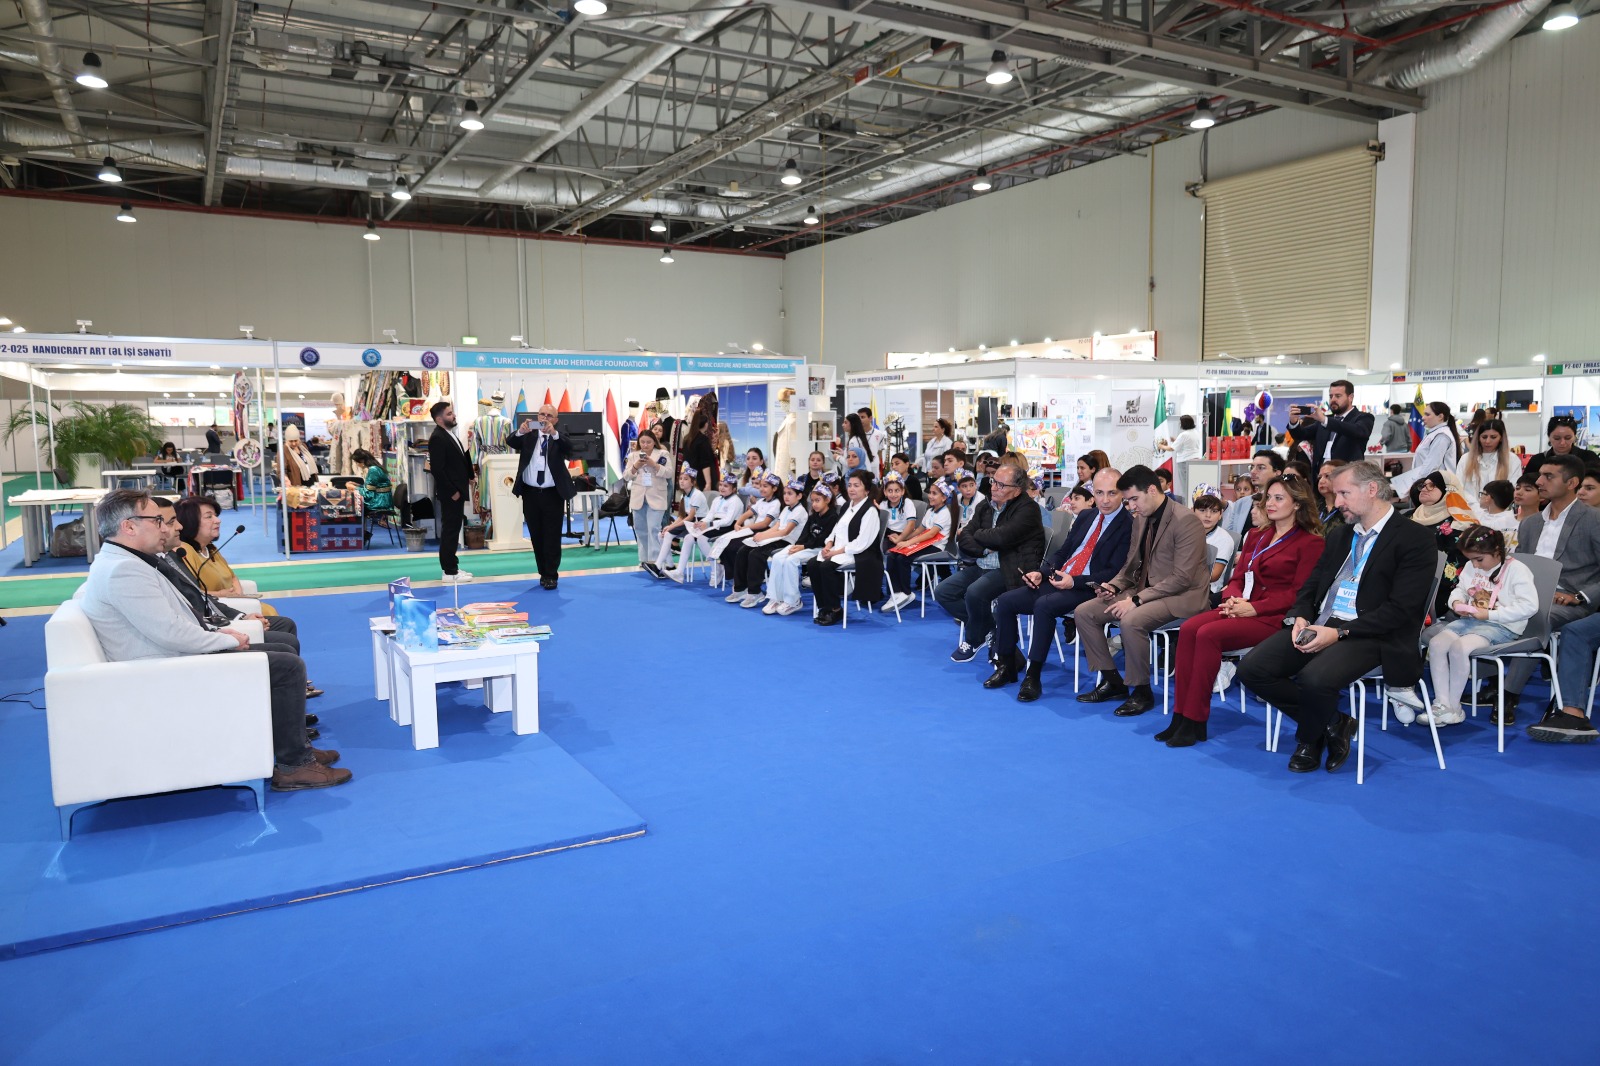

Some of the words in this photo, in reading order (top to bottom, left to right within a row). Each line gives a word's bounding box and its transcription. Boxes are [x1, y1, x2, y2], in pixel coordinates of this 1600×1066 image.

[32, 345, 87, 355] HANDICRAFT
[90, 346, 106, 355] ART
[124, 345, 135, 357] İŞİ
[137, 347, 171, 357] SƏNƏTİ)
[521, 357, 551, 365] CULTURE
[553, 358, 569, 366] AND
[571, 358, 603, 366] HERITAGE
[605, 359, 648, 368] FOUNDATION
[1119, 415, 1148, 423] México
